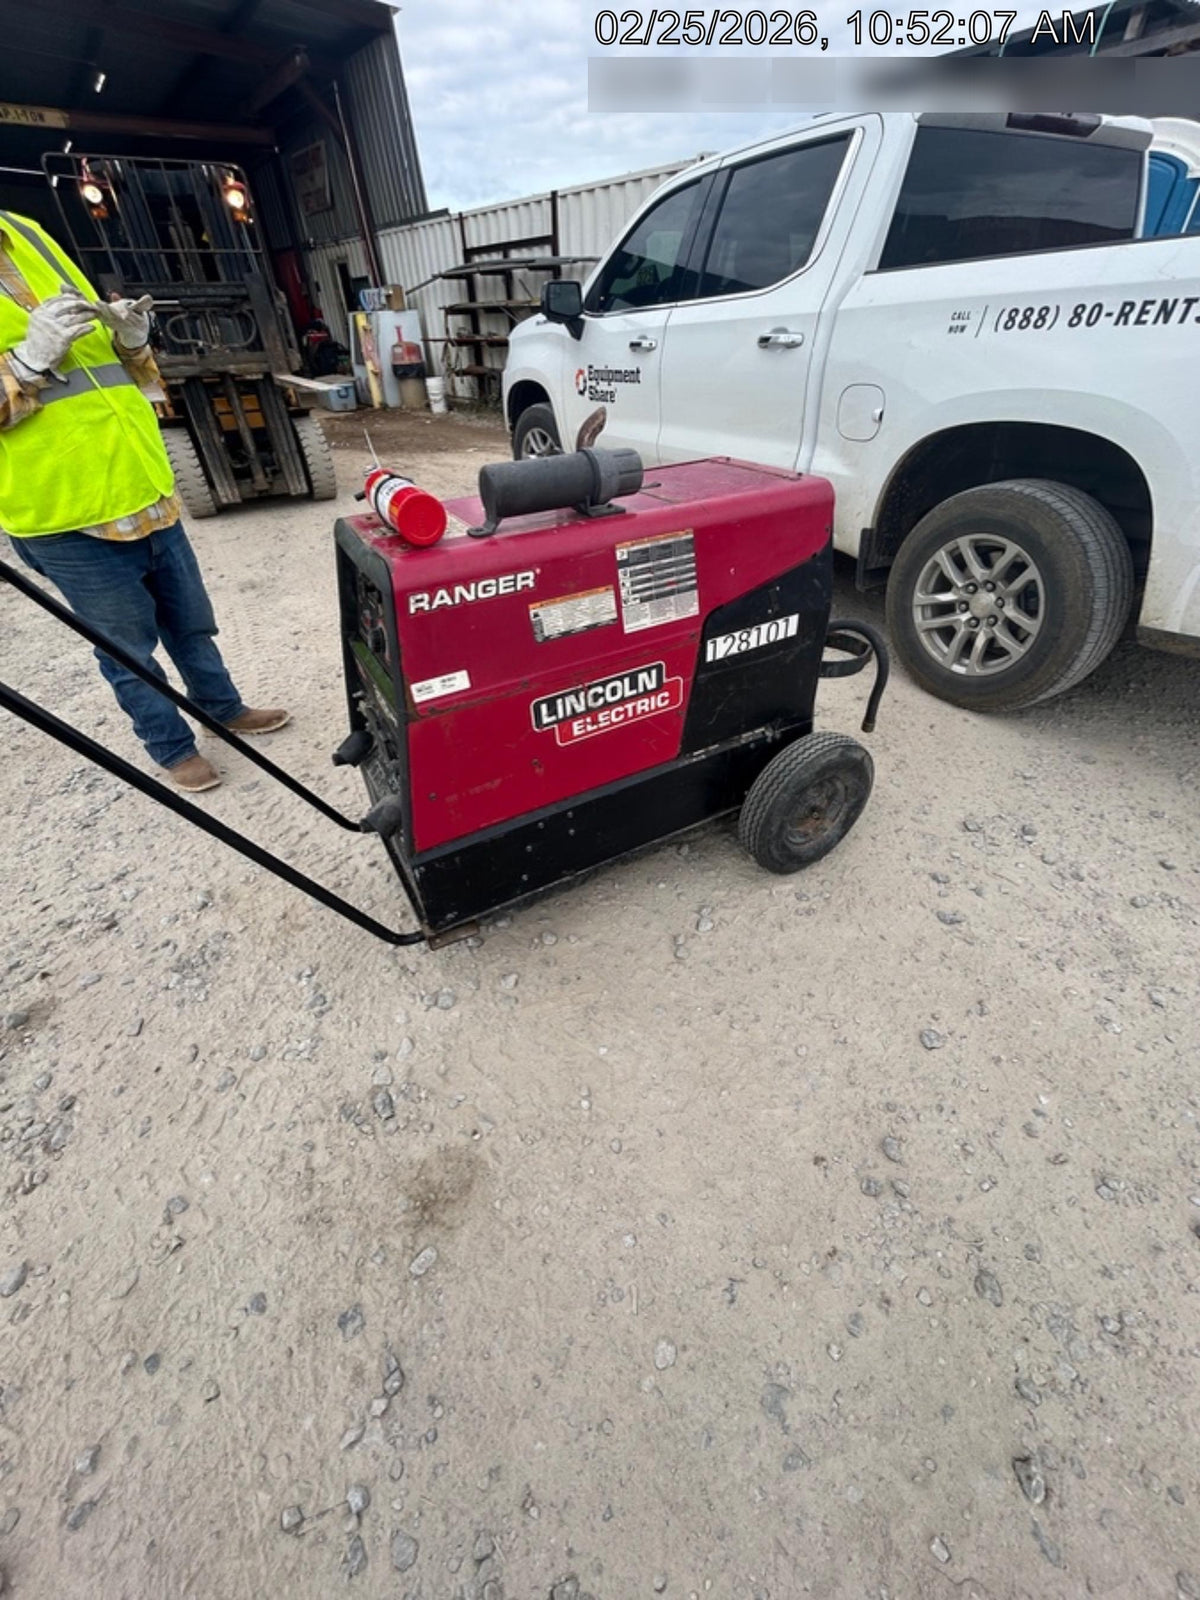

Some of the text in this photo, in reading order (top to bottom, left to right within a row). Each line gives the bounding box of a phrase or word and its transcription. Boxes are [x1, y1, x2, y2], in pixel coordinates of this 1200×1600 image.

[948, 325, 967, 334] NOW
[951, 311, 971, 321] CALL
[994, 297, 1200, 333] (888) 80-RENT
[588, 364, 641, 386] Equipment
[408, 570, 536, 615] RANGER
[709, 616, 791, 661] 128101
[540, 668, 658, 726] LINCOLN
[572, 691, 671, 738] ELECTRIC
